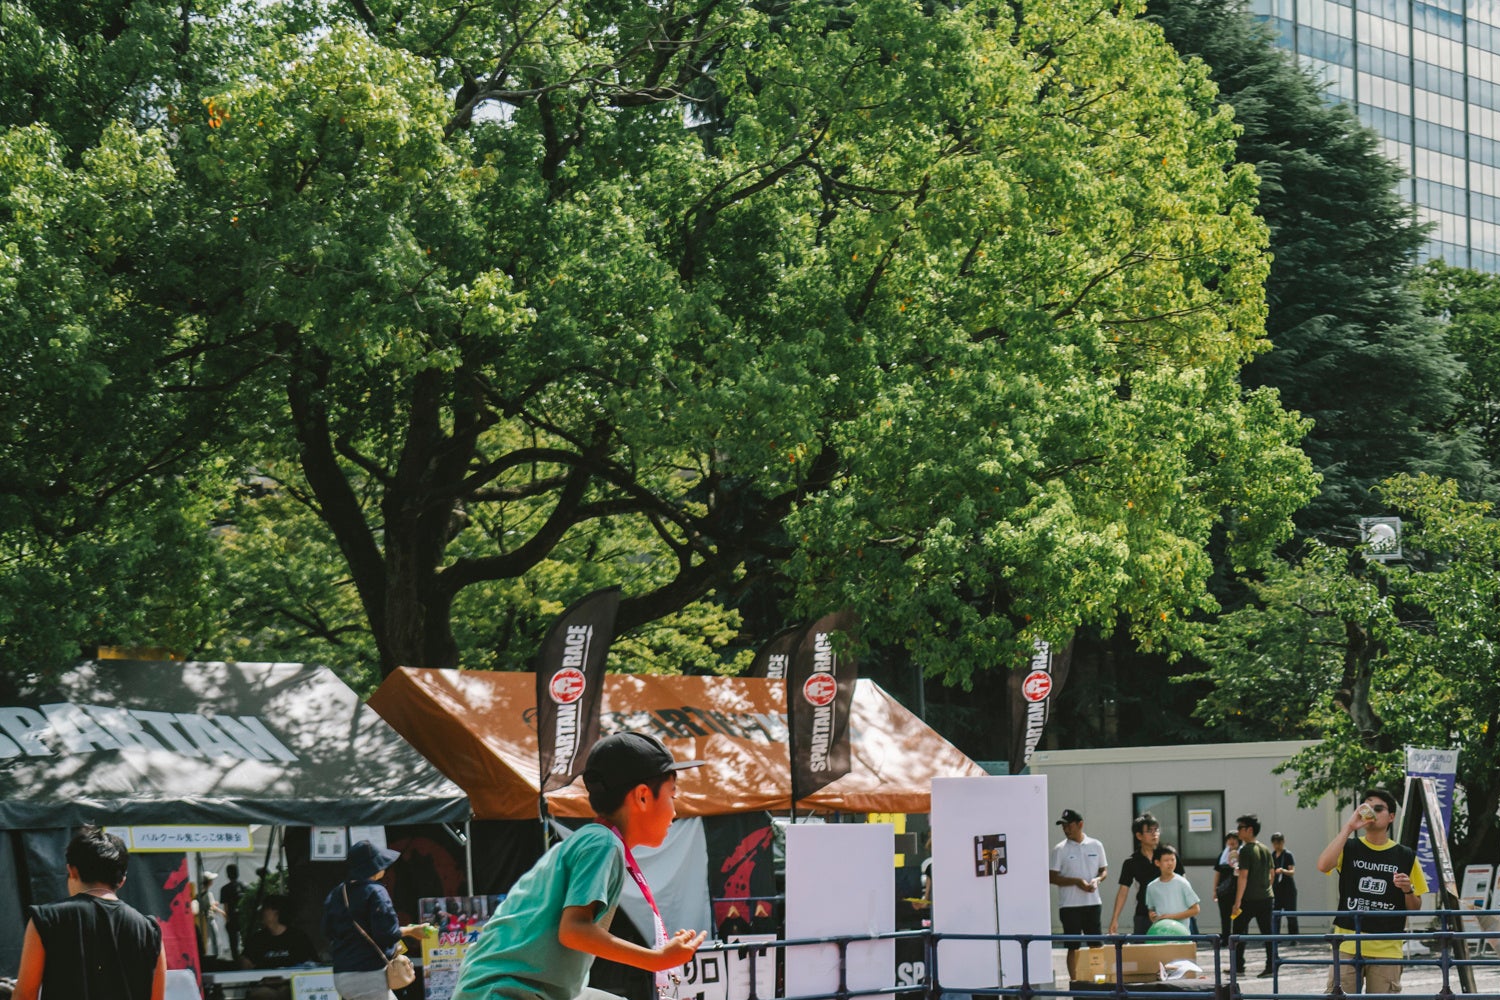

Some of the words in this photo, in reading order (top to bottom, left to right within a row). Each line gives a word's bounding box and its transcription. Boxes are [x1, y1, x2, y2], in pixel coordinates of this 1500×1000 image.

[562, 625, 588, 667] RACE
[767, 654, 785, 679] ACE
[551, 704, 577, 775] SPARTAN
[811, 706, 831, 773] SPARTAN
